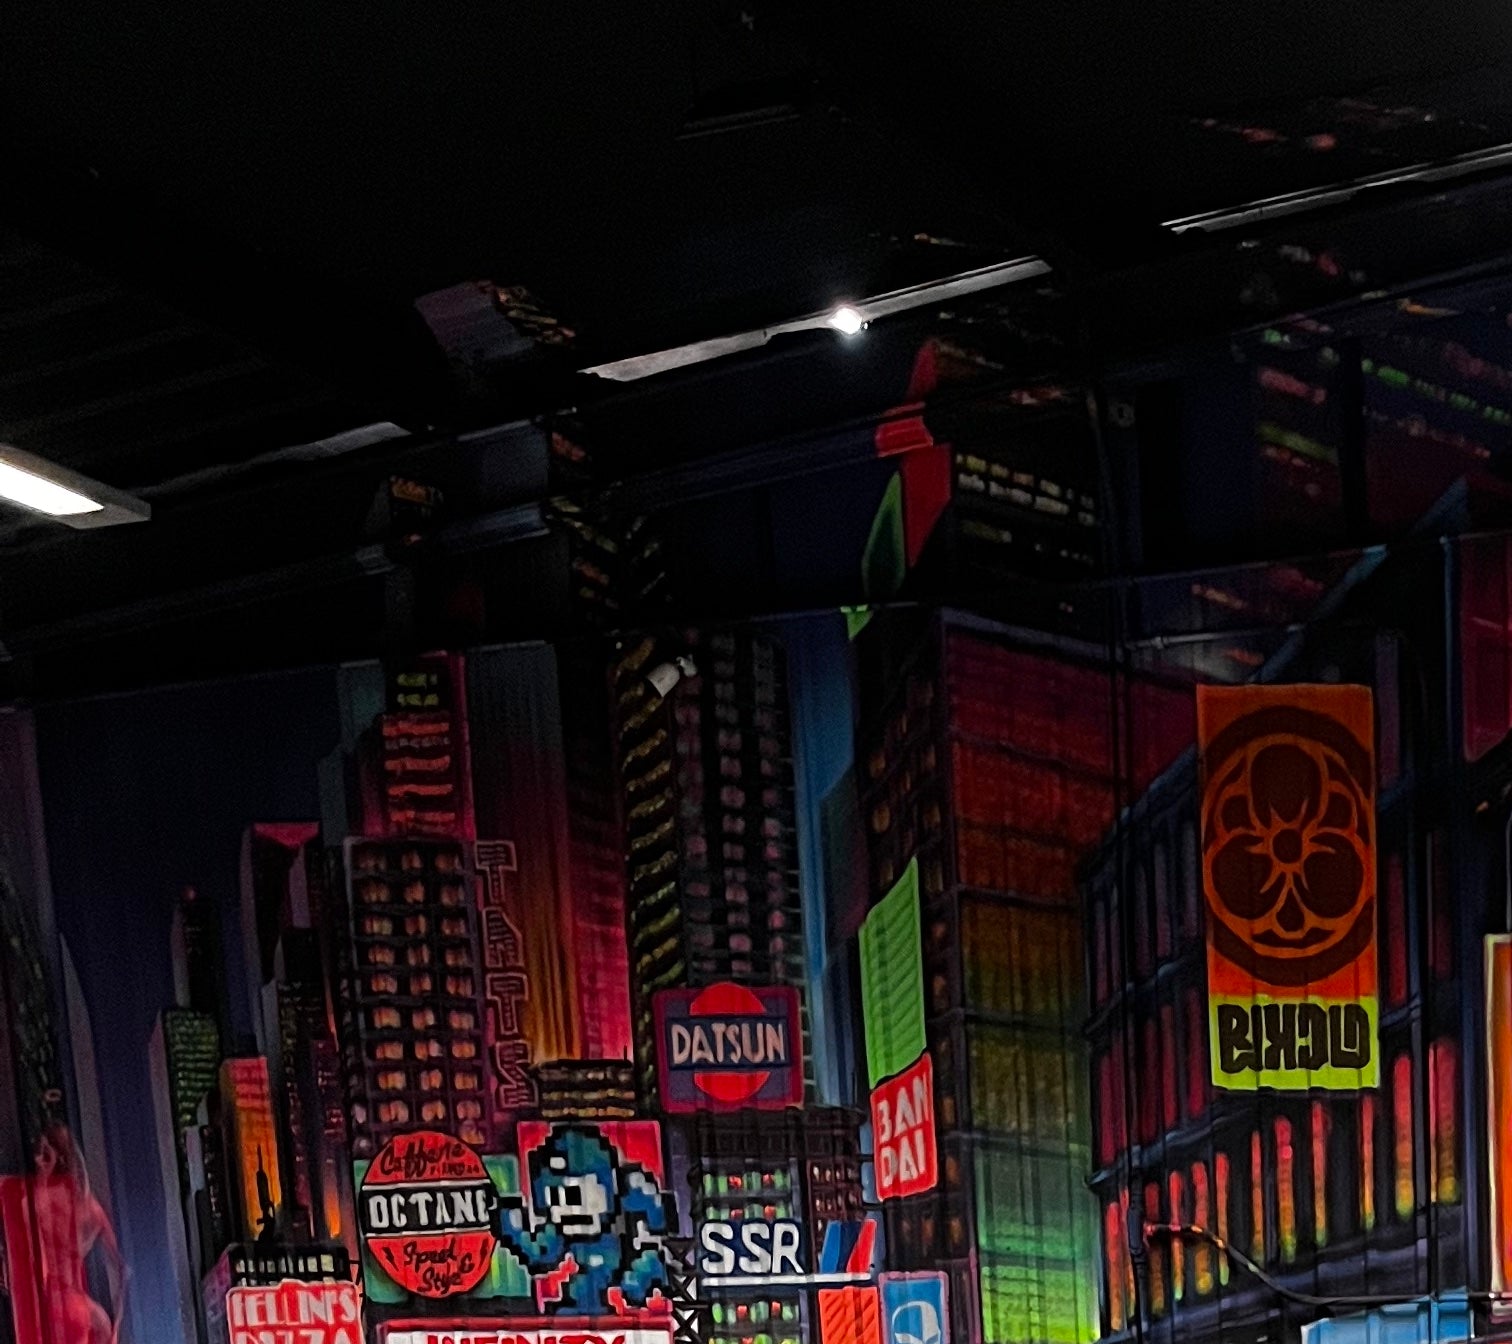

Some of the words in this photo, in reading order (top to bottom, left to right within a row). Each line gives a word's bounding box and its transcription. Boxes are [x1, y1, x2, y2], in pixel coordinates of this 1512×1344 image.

[670, 1022, 787, 1065] DATSUN
[877, 1071, 929, 1144] BAN
[880, 1129, 926, 1189] DAI
[368, 1189, 490, 1228] OCTANE
[701, 1221, 803, 1275] SSR
